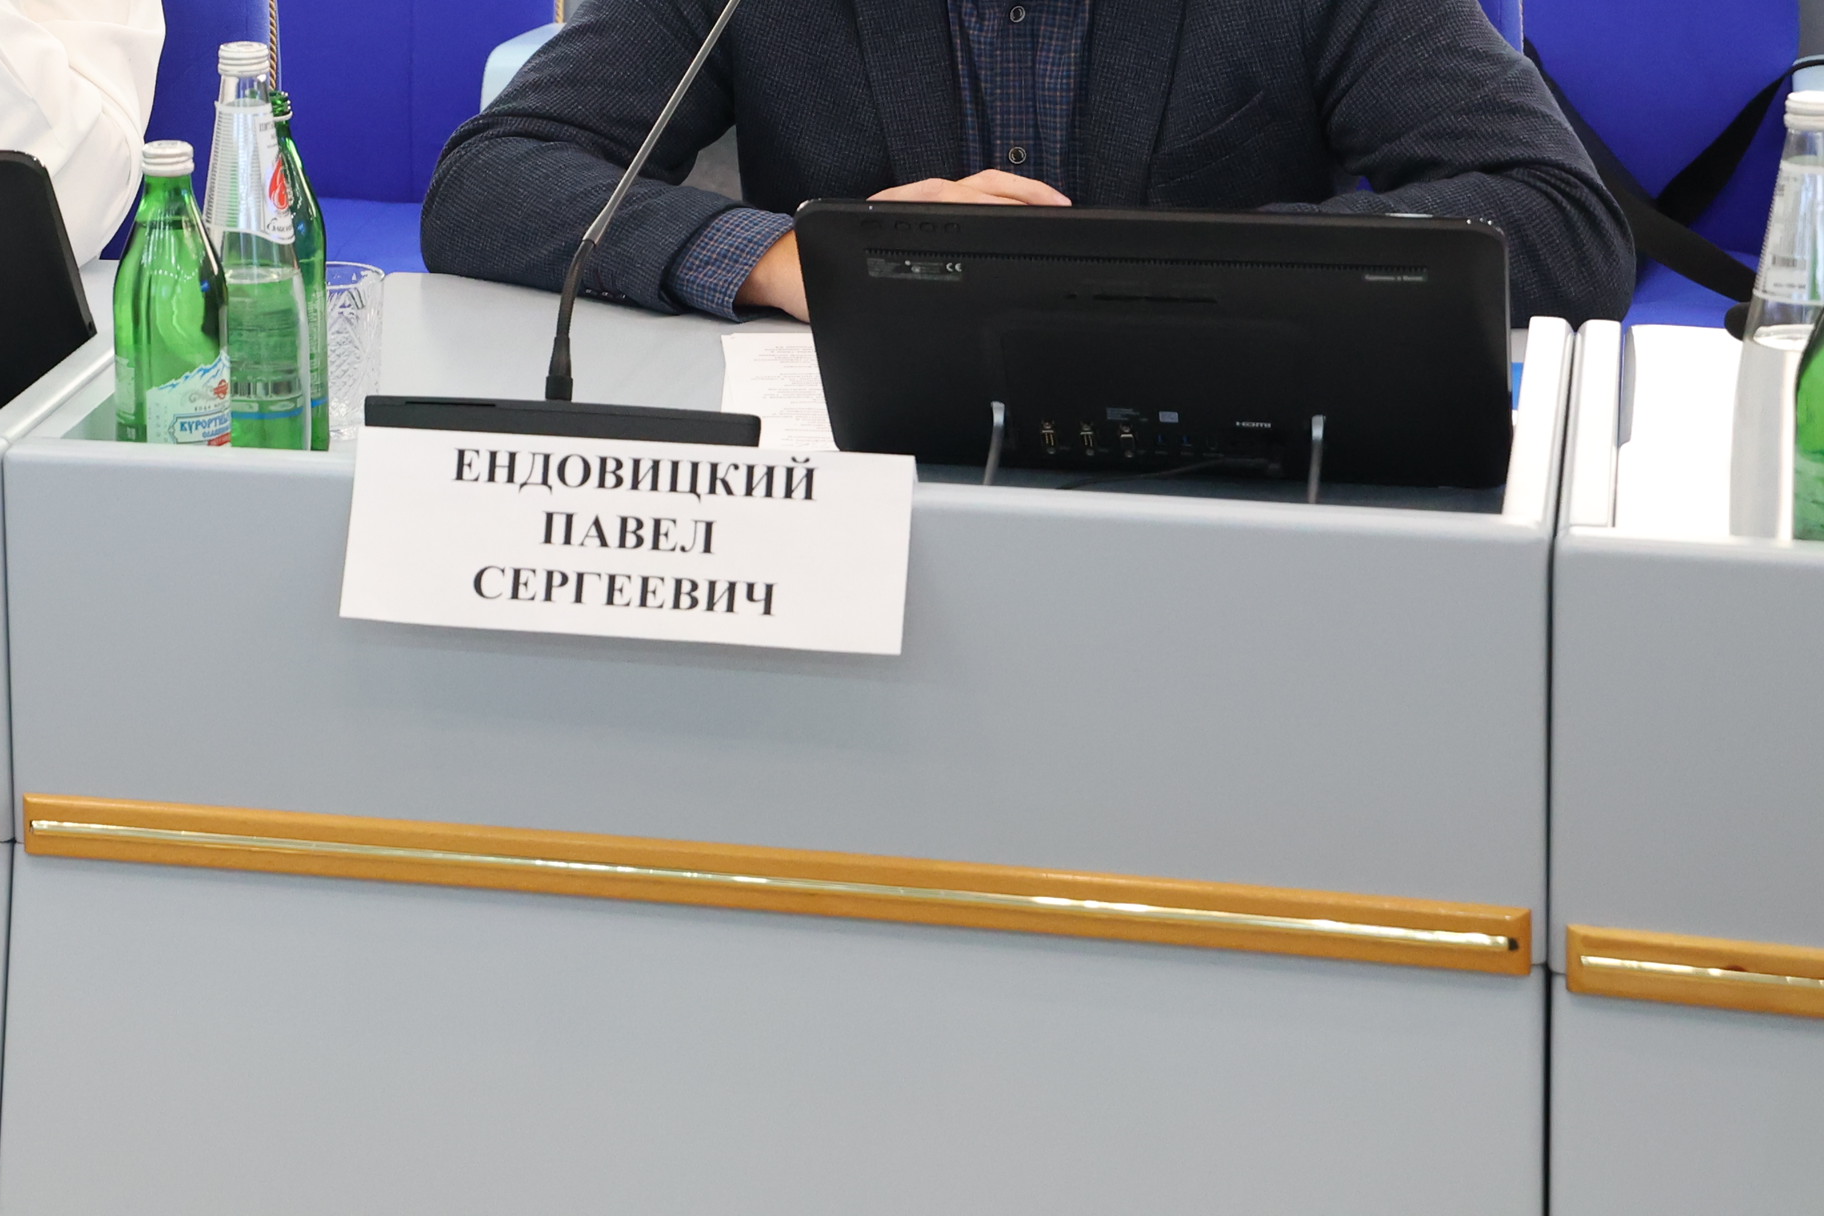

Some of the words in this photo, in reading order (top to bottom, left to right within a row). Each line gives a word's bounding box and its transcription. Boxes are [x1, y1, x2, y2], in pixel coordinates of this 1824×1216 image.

[452, 448, 816, 501] ЕНДОВИЦКИЙ
[540, 511, 715, 555] ПАВЕЛ
[473, 565, 775, 616] СЕРГЕЕВИЧ
